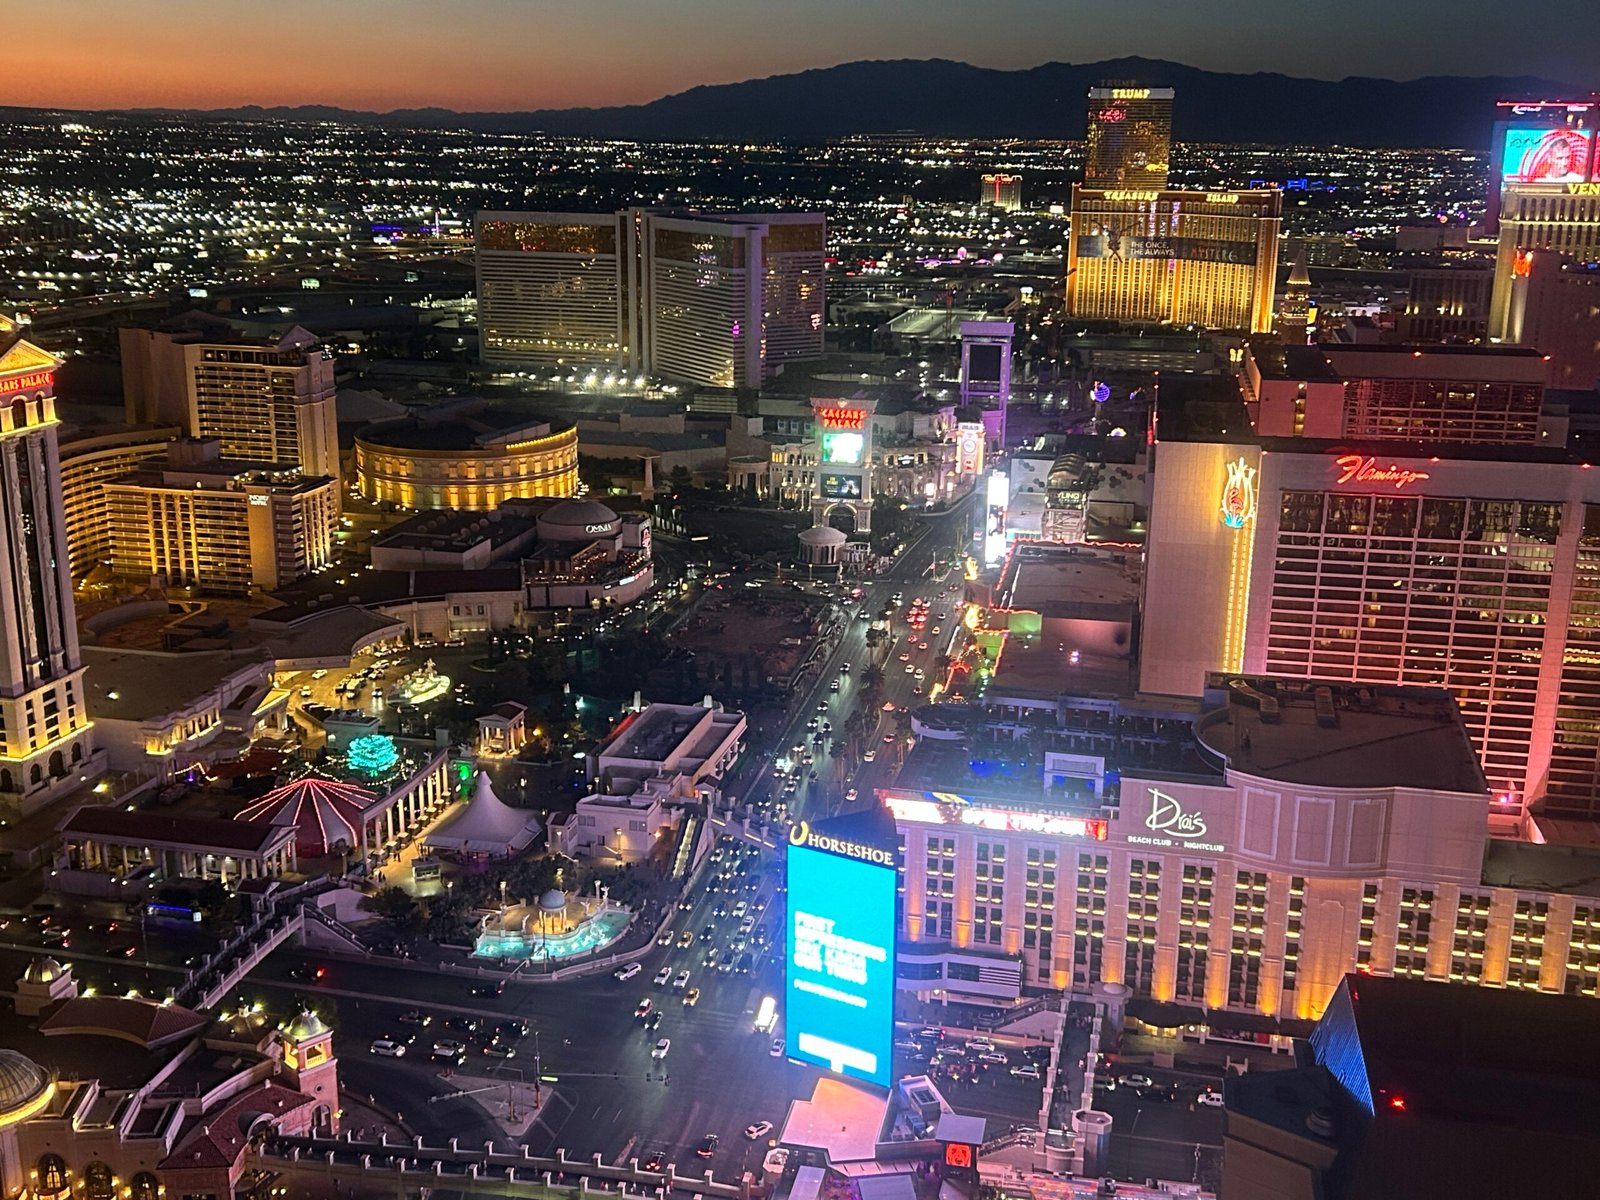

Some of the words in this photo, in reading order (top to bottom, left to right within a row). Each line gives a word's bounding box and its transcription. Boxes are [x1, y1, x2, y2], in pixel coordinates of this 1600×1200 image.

[1112, 88, 1150, 99] TRUMP
[1103, 191, 1159, 202] TREASURE
[1206, 193, 1239, 204] ISLAND
[20, 371, 50, 389] PALACE
[822, 409, 866, 420] CAESARS
[823, 418, 863, 430] PALACE
[1336, 455, 1430, 489] Flamingo
[585, 523, 612, 534] OMNIA
[1145, 788, 1207, 837] Drai's
[808, 833, 894, 866] HORSESHOE
[1127, 835, 1151, 845] BEACH
[1152, 838, 1172, 847] CLUB
[1183, 841, 1225, 852] NIGHTCLUB
